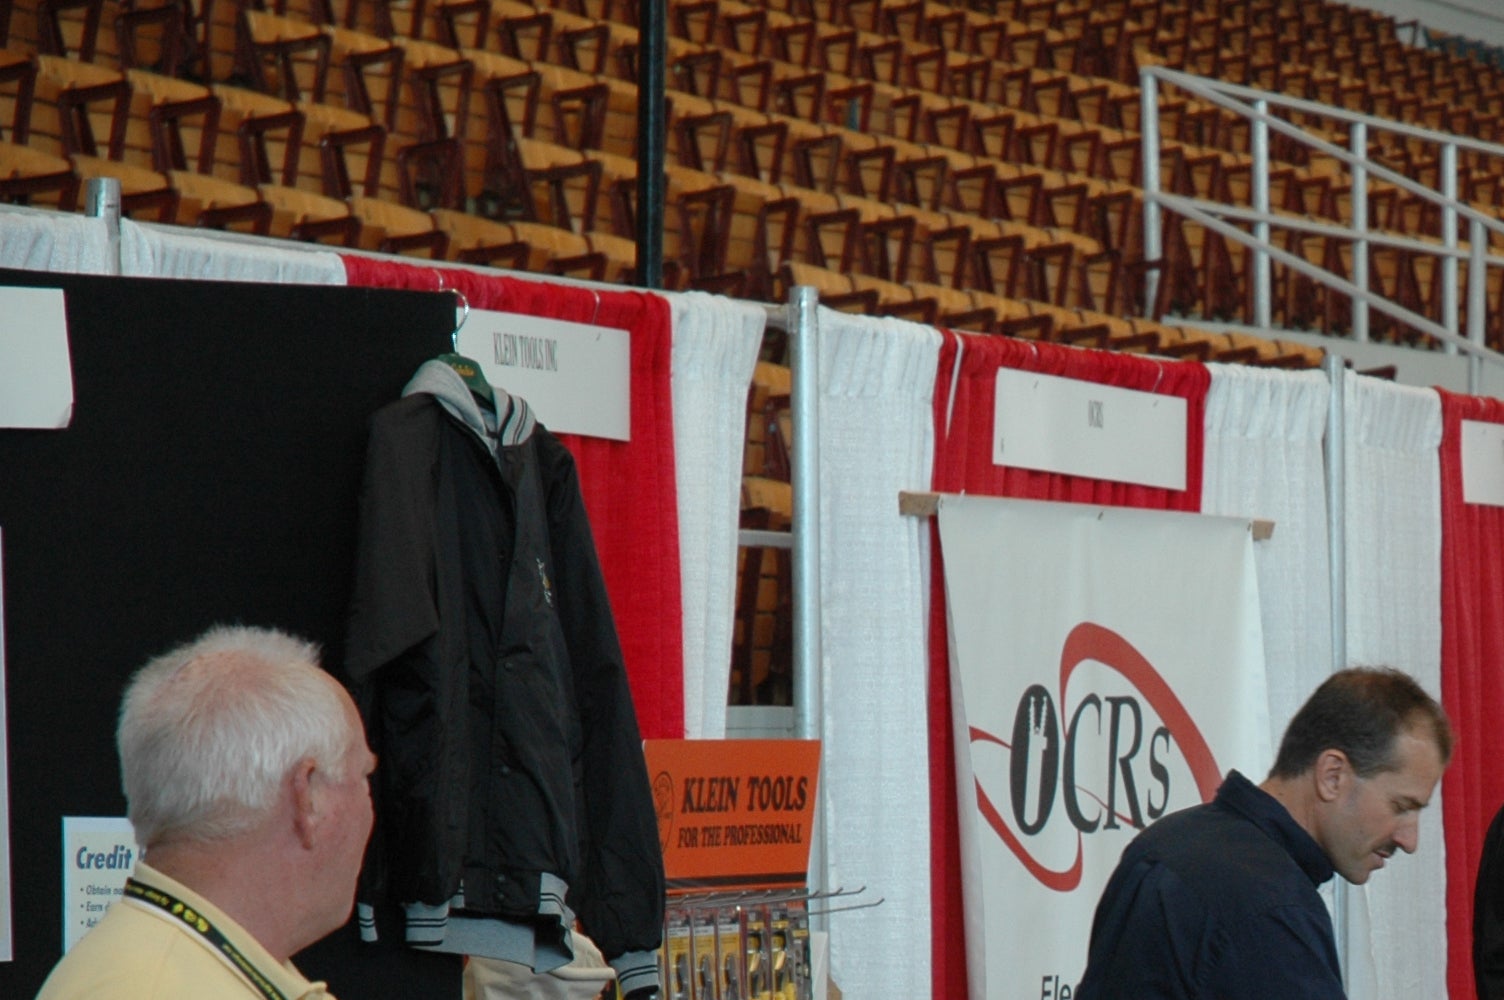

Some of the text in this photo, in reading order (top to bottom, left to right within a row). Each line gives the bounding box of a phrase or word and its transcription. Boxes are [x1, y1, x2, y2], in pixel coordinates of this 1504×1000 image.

[493, 332, 517, 366] KLEIN
[519, 335, 544, 370] TOOLS
[1010, 684, 1170, 834] OCRs
[681, 775, 809, 814] KLEIN TOOLS
[678, 822, 802, 849] FOR THE PROFESSIONAL
[76, 845, 133, 870] Credit
